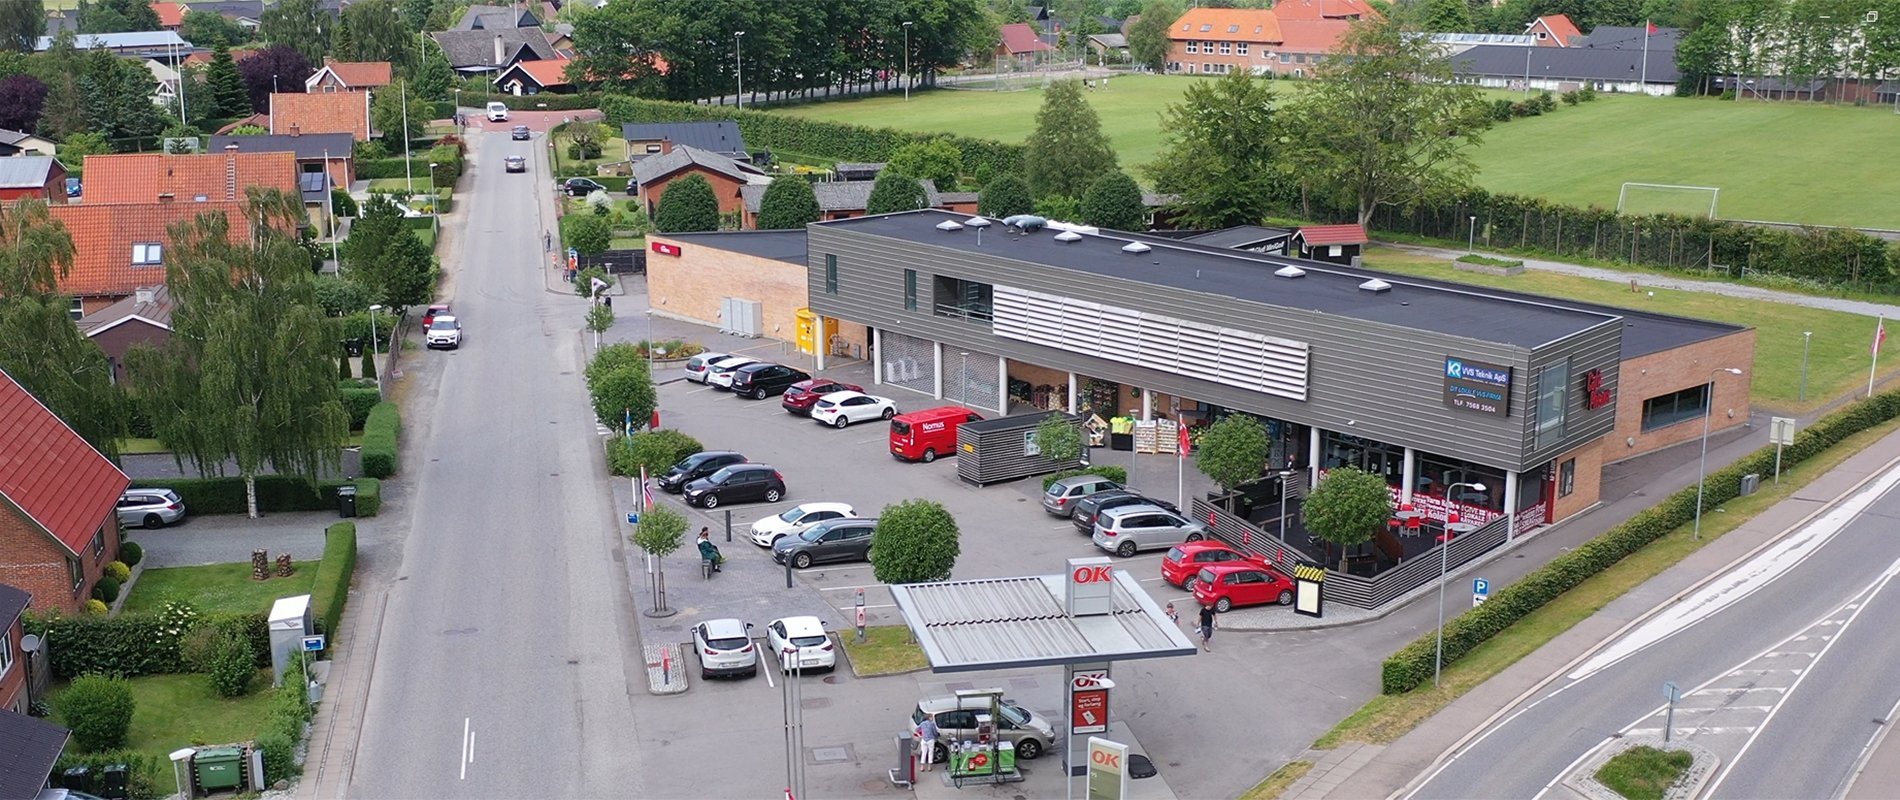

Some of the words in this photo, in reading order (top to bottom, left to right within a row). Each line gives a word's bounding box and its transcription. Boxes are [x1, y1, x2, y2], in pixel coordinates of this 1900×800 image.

[1462, 367, 1475, 377] VVS
[1475, 369, 1493, 379] Teknik
[1493, 373, 1507, 383] ApS
[1073, 565, 1112, 584] OK
[1476, 582, 1486, 592] P
[1075, 674, 1105, 687] OK
[1092, 750, 1119, 768] OK
